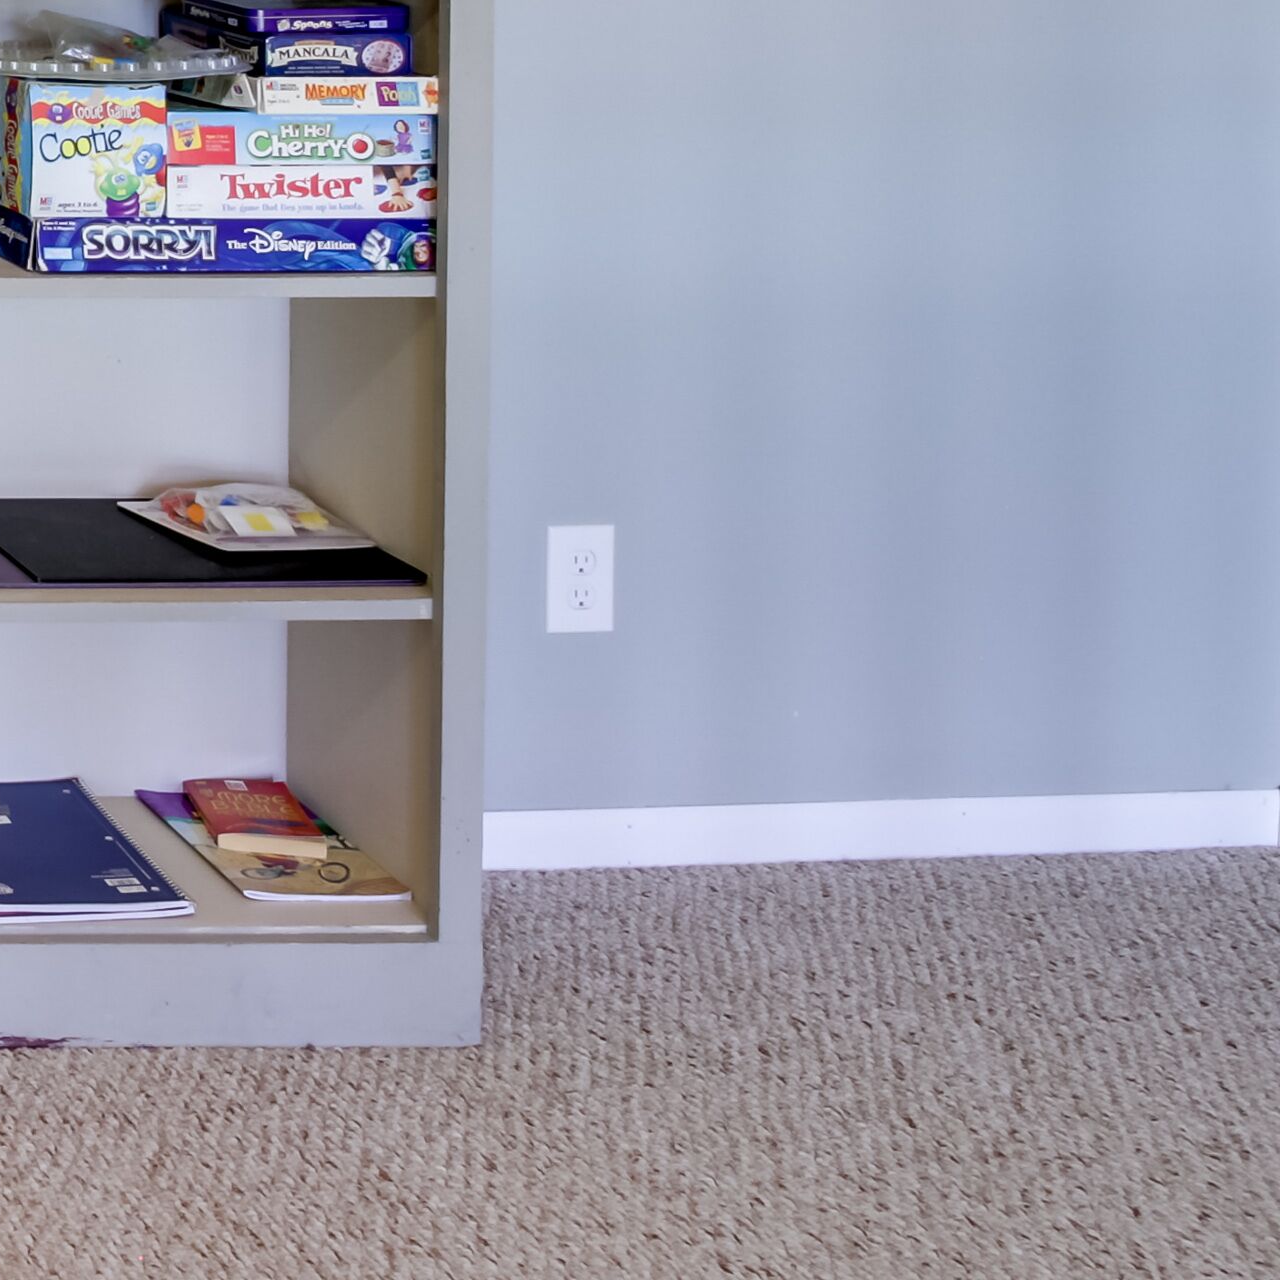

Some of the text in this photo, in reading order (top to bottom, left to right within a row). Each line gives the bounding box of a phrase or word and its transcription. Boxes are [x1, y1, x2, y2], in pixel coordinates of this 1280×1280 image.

[290, 20, 333, 31] Spoons
[279, 47, 350, 60] MANCALA
[304, 83, 367, 101] MEMORY
[72, 102, 141, 120] Cootie Games
[280, 123, 331, 138] Hi Ho!
[40, 124, 124, 163] Cootie
[246, 130, 376, 160] Cherry-O
[220, 172, 363, 200] Twister
[262, 204, 278, 212] that
[298, 205, 313, 213] you
[316, 204, 327, 212] up
[82, 222, 216, 262] SORRY!
[226, 239, 248, 250] The
[317, 239, 357, 250] Edition
[216, 792, 286, 802] MORE
[210, 800, 295, 816] BIBLE
